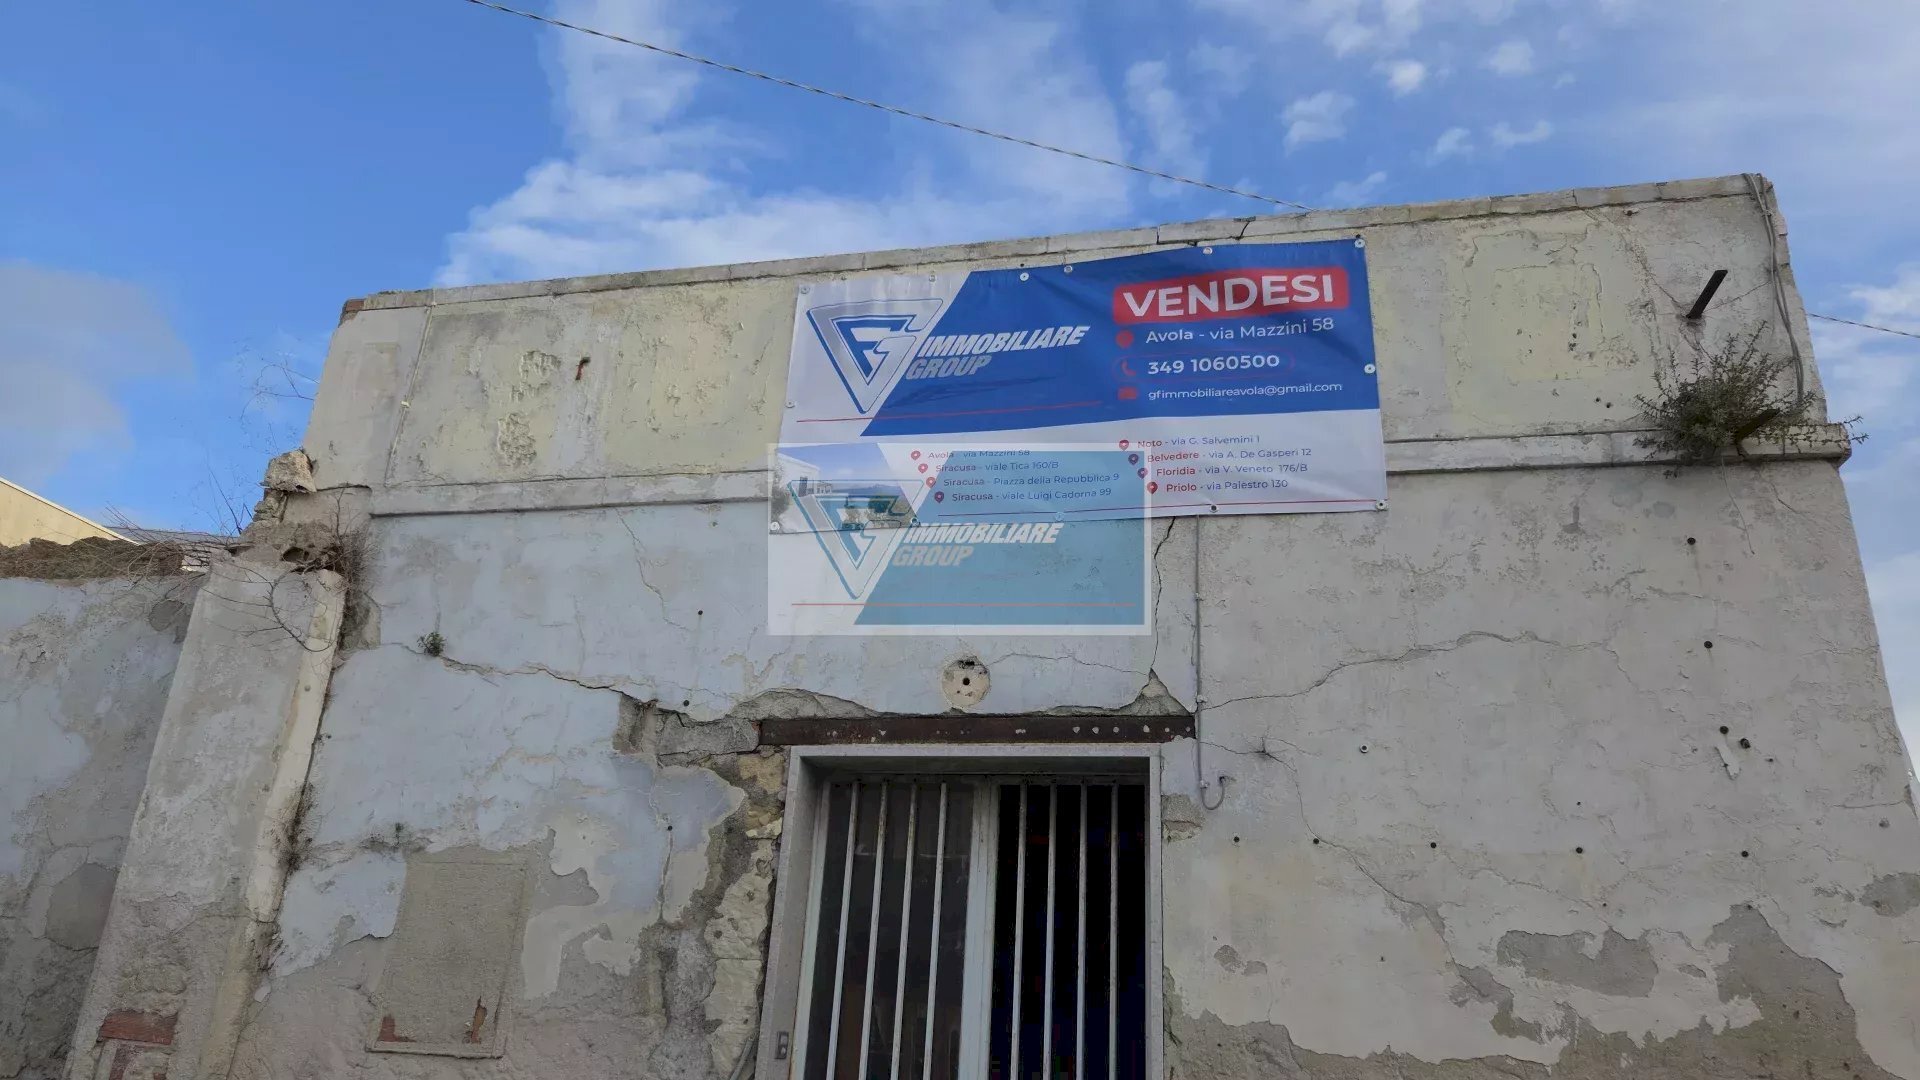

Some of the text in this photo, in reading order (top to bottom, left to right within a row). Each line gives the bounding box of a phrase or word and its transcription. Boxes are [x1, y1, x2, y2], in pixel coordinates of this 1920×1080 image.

[1123, 274, 1334, 317] VENDESI
[1145, 330, 1193, 343] Avola
[1209, 327, 1234, 340] via
[1240, 319, 1307, 338] Mazzini
[1312, 317, 1334, 331] 58
[918, 326, 1090, 357] IMMOBILIARE
[906, 355, 992, 380] GROUP
[1148, 354, 1280, 374] 349 1060500
[1148, 382, 1342, 400] gfimmobiliareavola@gmail.com
[1138, 439, 1162, 448] Noto
[1171, 436, 1186, 445] via
[1189, 437, 1199, 445] G.
[1202, 435, 1253, 445] Salvemini
[928, 451, 954, 459] Avola
[963, 450, 976, 458] via
[979, 450, 1016, 458] Mazzini
[1147, 452, 1199, 462] Belvedere
[1208, 451, 1223, 459] via
[1227, 451, 1237, 459] A.
[1240, 450, 1255, 458] De
[1257, 447, 1299, 459] Gasperi
[1301, 448, 1311, 456] 12
[935, 463, 976, 473] Siracusa
[985, 461, 1008, 471] viale
[1010, 462, 1030, 471] Tica
[1032, 461, 1059, 470] 160/B
[1156, 467, 1195, 476] Floridia
[1205, 465, 1220, 474] via
[1223, 465, 1233, 473] V.
[1235, 464, 1273, 473] Veneto
[1278, 463, 1308, 473] 176/B
[943, 477, 985, 487] Siracusa
[993, 477, 1025, 486] Piazza
[1027, 476, 1051, 485] della
[1053, 473, 1110, 484] Repubblica
[1113, 473, 1119, 481] 9
[1166, 482, 1197, 492] Priolo
[1206, 481, 1221, 490] via
[1224, 479, 1268, 489] Palestro
[1271, 479, 1288, 488] 130
[952, 492, 993, 501] Siracusa
[1002, 490, 1025, 500] viale
[1028, 490, 1052, 502] Luigi
[1054, 488, 1097, 500] Cadorna
[1099, 487, 1112, 496] 99
